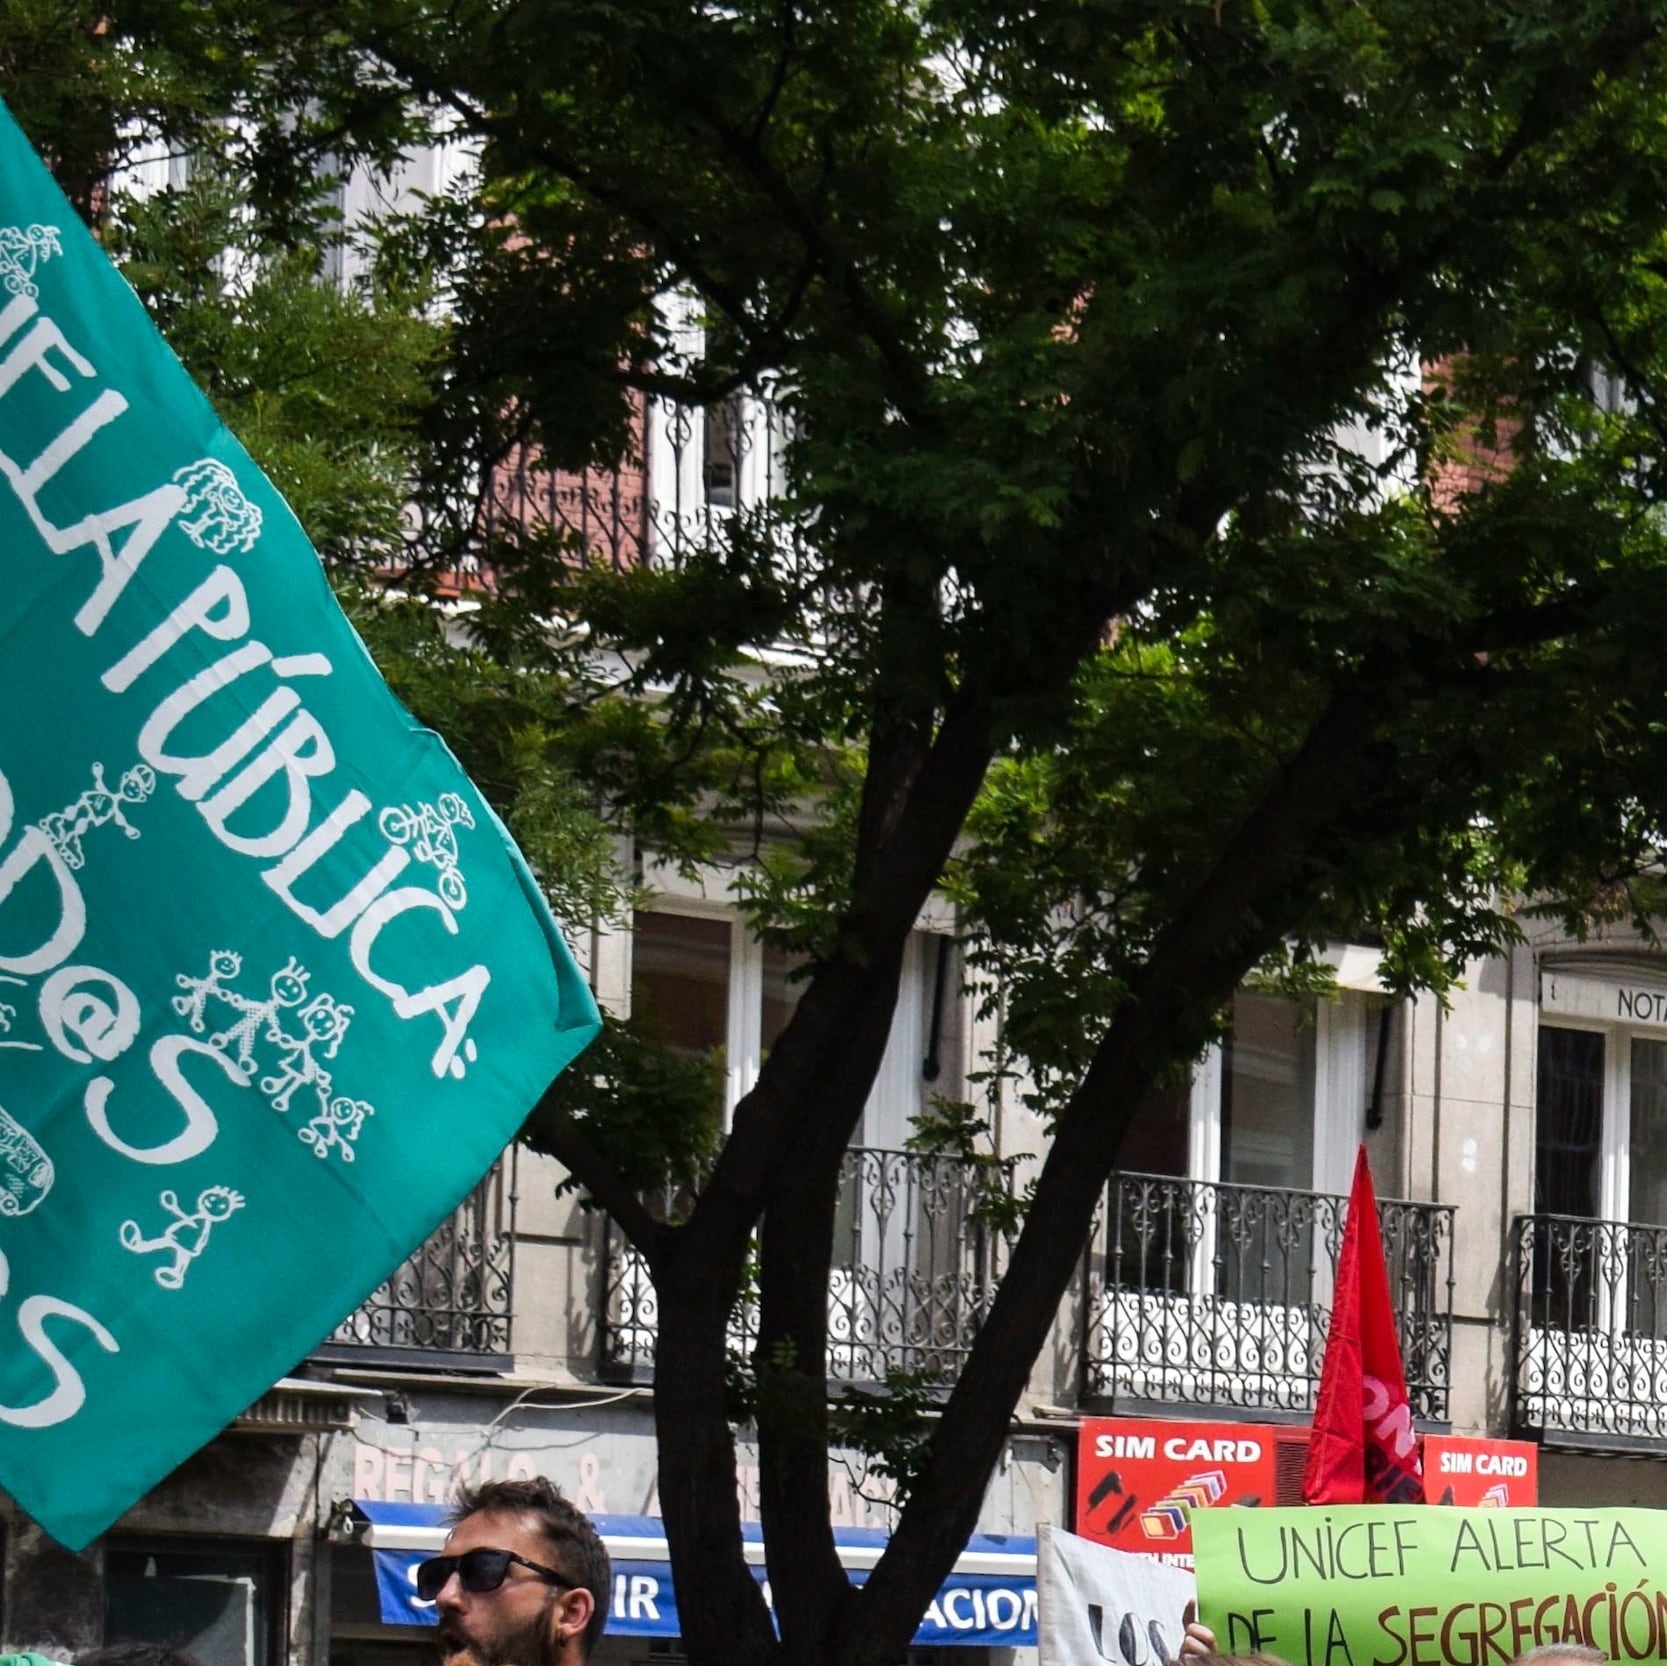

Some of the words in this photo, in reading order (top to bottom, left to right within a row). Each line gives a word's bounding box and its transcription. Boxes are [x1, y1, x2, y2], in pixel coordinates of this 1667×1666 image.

[0, 770, 252, 1166] D@S
[1095, 1434, 1156, 1460] SIM
[1164, 1437, 1262, 1463] CARD
[1440, 1450, 1473, 1474] SIM
[1474, 1453, 1528, 1477] CARD
[1450, 1517, 1648, 1574] ALERTA
[1161, 1551, 1195, 1570] INTE
